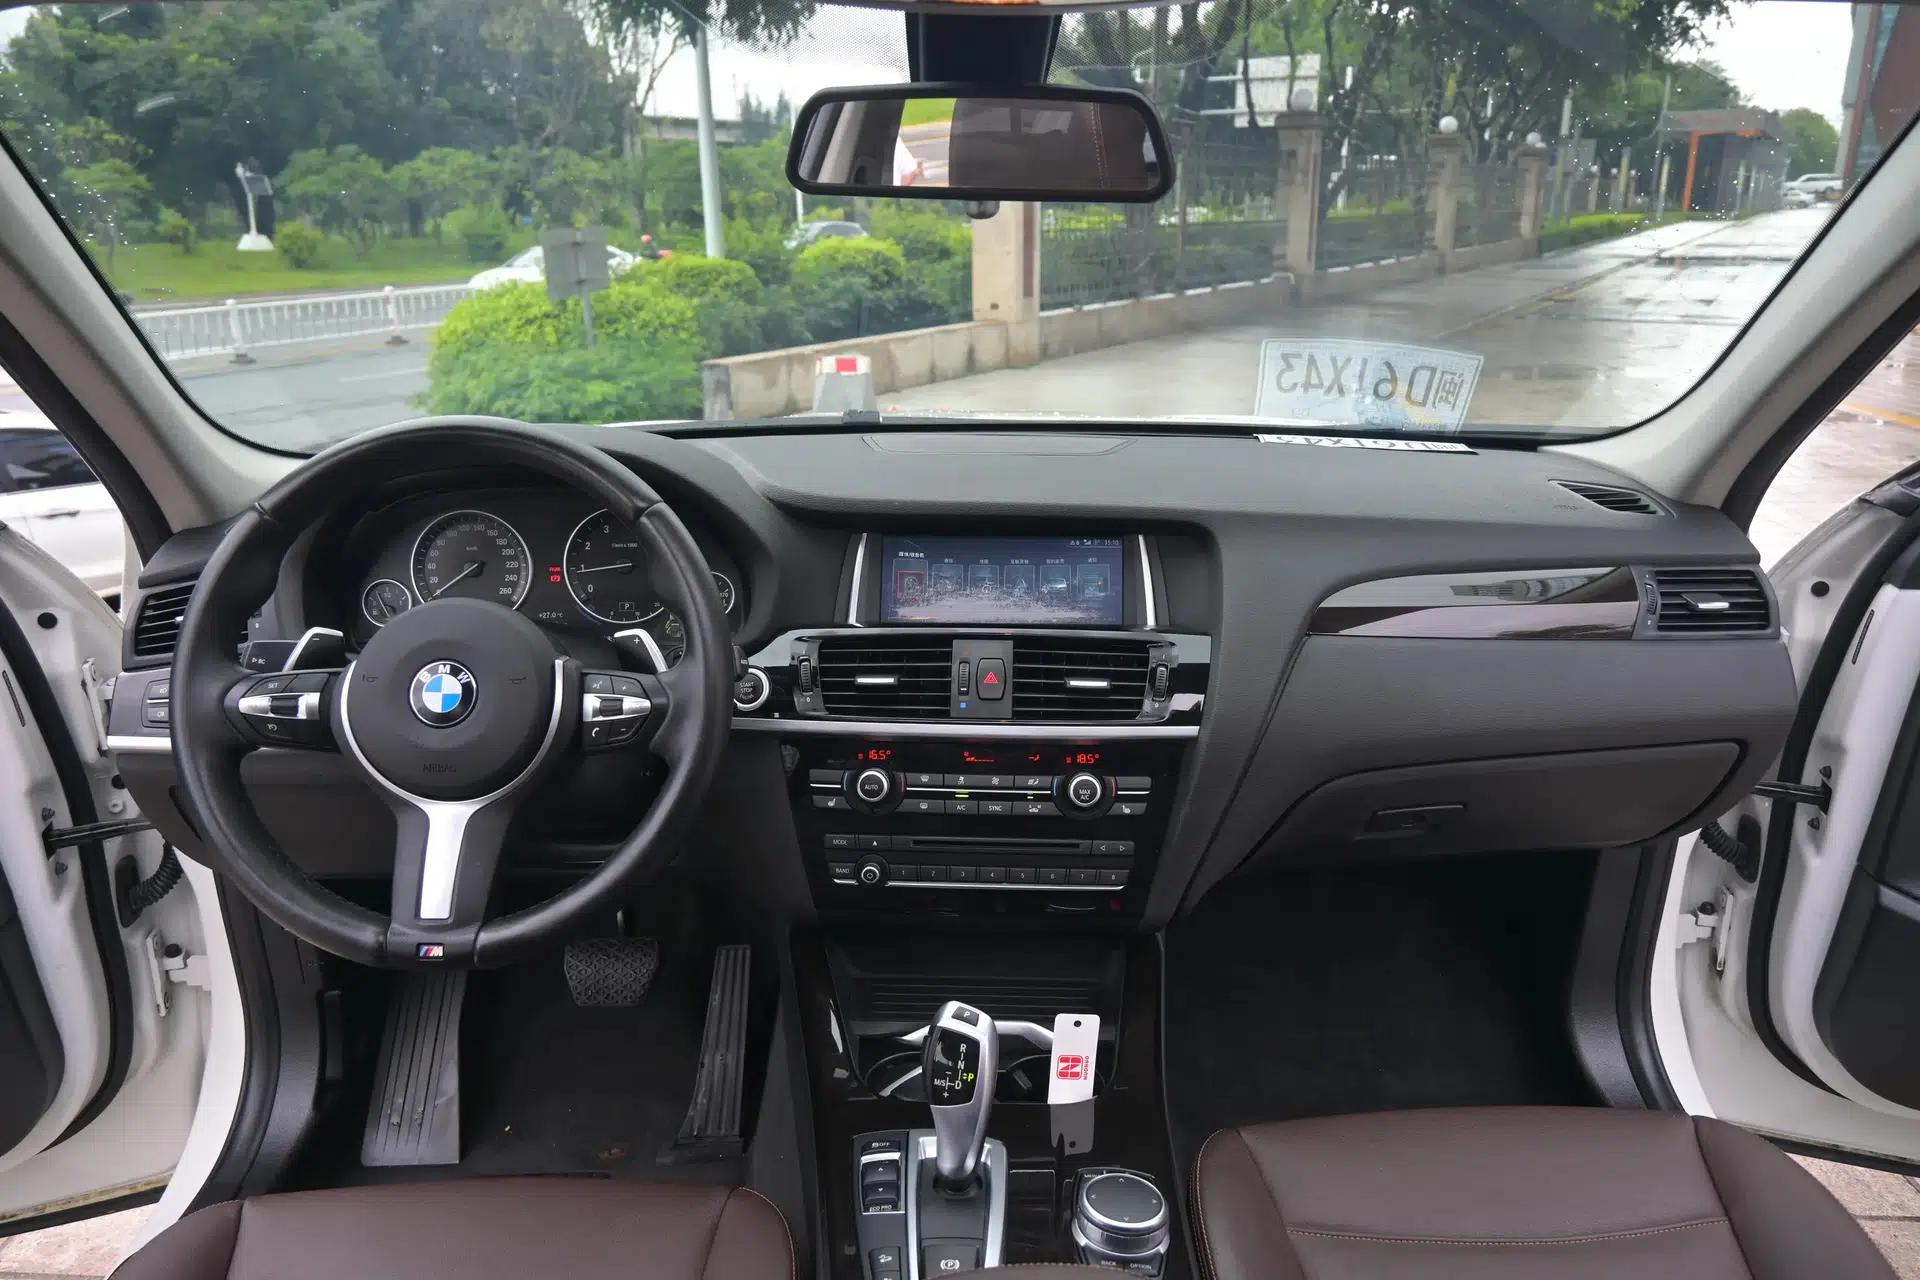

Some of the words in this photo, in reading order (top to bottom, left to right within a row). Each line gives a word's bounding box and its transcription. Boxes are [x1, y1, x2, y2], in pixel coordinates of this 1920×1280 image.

[603, 525, 609, 533] 3
[585, 542, 591, 550] 2
[588, 584, 594, 592] 0
[419, 664, 470, 684] BMW
[960, 1043, 967, 1053] R
[957, 1061, 965, 1070] N
[968, 1073, 974, 1082] P
[934, 1078, 946, 1087] M/S
[954, 1081, 961, 1089] D
